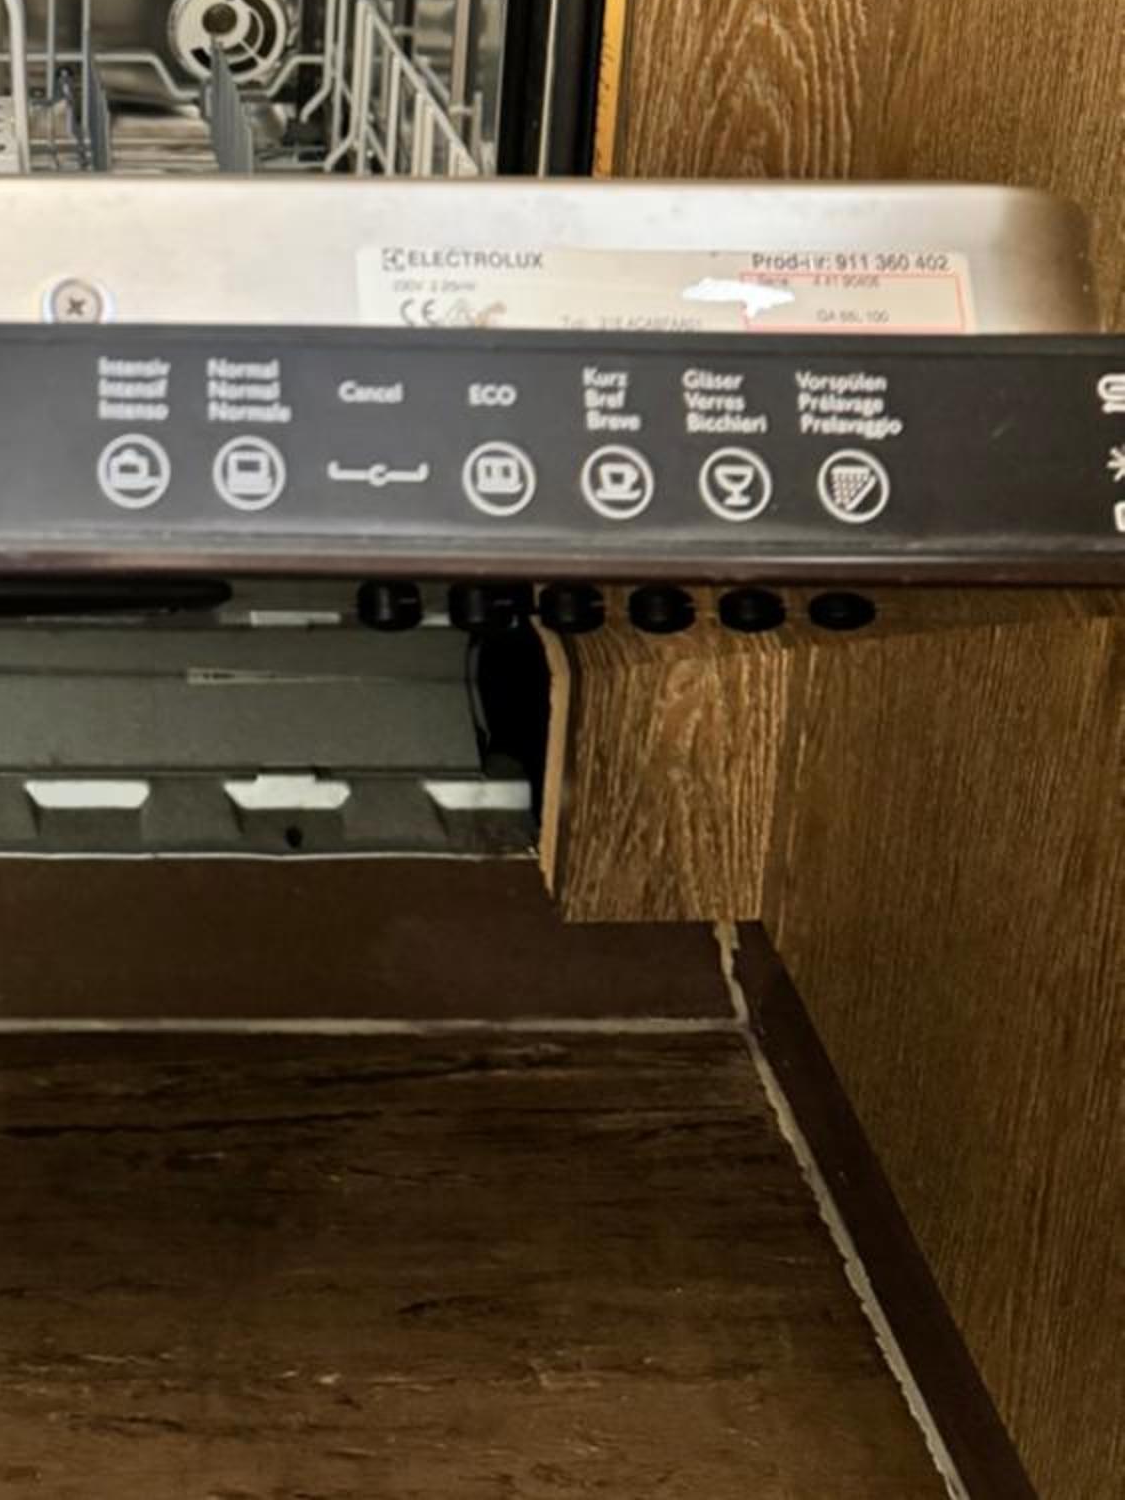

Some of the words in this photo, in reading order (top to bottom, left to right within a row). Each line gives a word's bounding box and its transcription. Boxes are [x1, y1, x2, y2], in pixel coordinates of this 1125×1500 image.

[408, 250, 543, 269] ELECTROLUX
[835, 252, 868, 271] 911
[875, 253, 909, 271] 360
[915, 254, 949, 272] 402
[98, 357, 170, 377] Intensiv
[207, 358, 280, 379] Normal
[582, 368, 629, 388] Kurz
[682, 369, 743, 390] Gläser
[795, 371, 887, 393] Vorspülen
[98, 379, 169, 398] Intensif
[207, 380, 280, 400] Normal
[338, 381, 403, 404] Cancel
[468, 384, 517, 407] ECO
[584, 389, 626, 409] Bref
[684, 392, 745, 411] Verres
[798, 393, 884, 418] Prélavage
[98, 401, 169, 420] Intenso
[208, 402, 291, 423] Normale
[586, 411, 641, 431] Breve
[686, 413, 767, 434] Bicchieri
[801, 415, 903, 439] Prelavaggio
